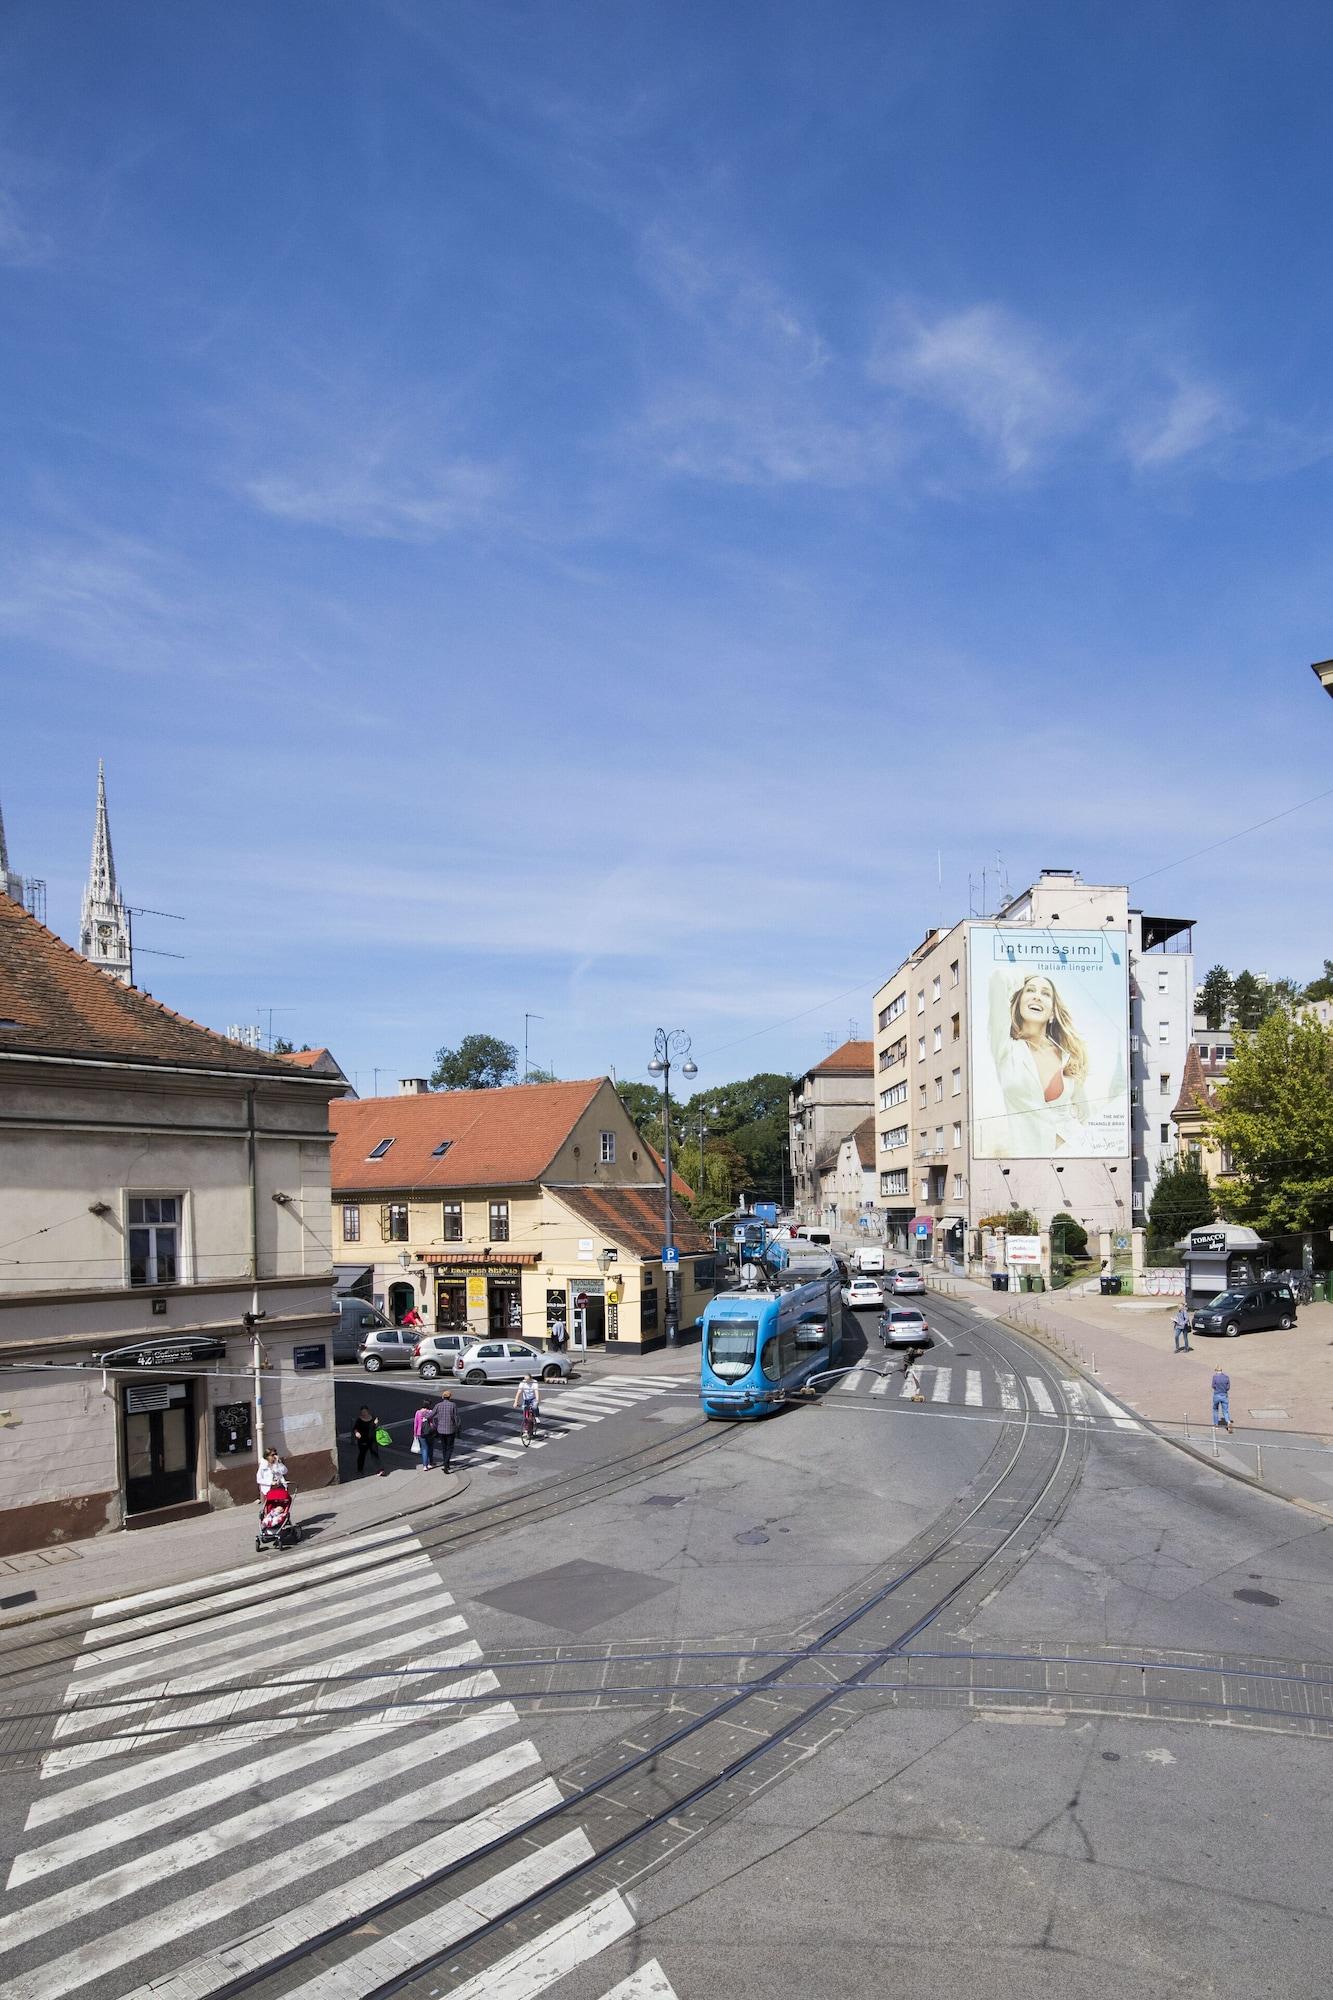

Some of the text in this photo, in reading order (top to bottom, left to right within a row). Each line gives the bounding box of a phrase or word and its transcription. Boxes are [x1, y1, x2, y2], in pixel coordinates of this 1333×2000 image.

[1000, 943, 1097, 955] intimissimi
[1037, 963, 1104, 973] Italian lingerie
[1191, 1233, 1225, 1245] TOBACCO
[1208, 1240, 1224, 1252] shop
[667, 1250, 675, 1260] P
